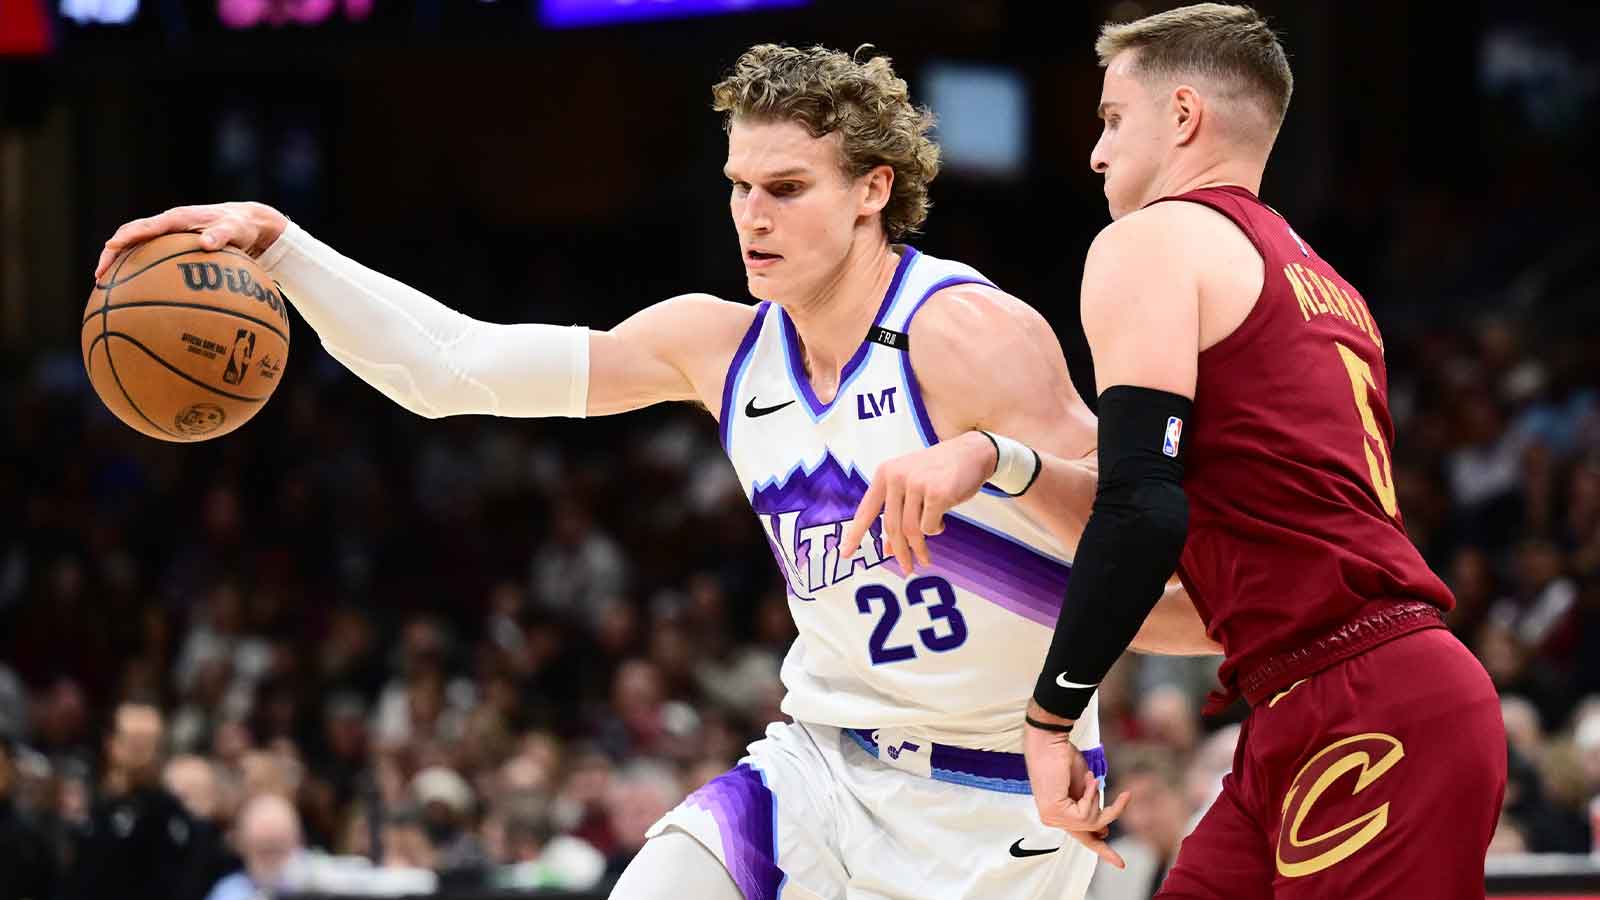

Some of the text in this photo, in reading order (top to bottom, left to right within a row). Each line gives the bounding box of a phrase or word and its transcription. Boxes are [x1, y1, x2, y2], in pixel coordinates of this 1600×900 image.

[1283, 263, 1384, 357] MERRIL
[857, 386, 897, 420] LVT
[1335, 341, 1397, 518] 5
[757, 510, 896, 600] UTA
[854, 575, 968, 665] 23
